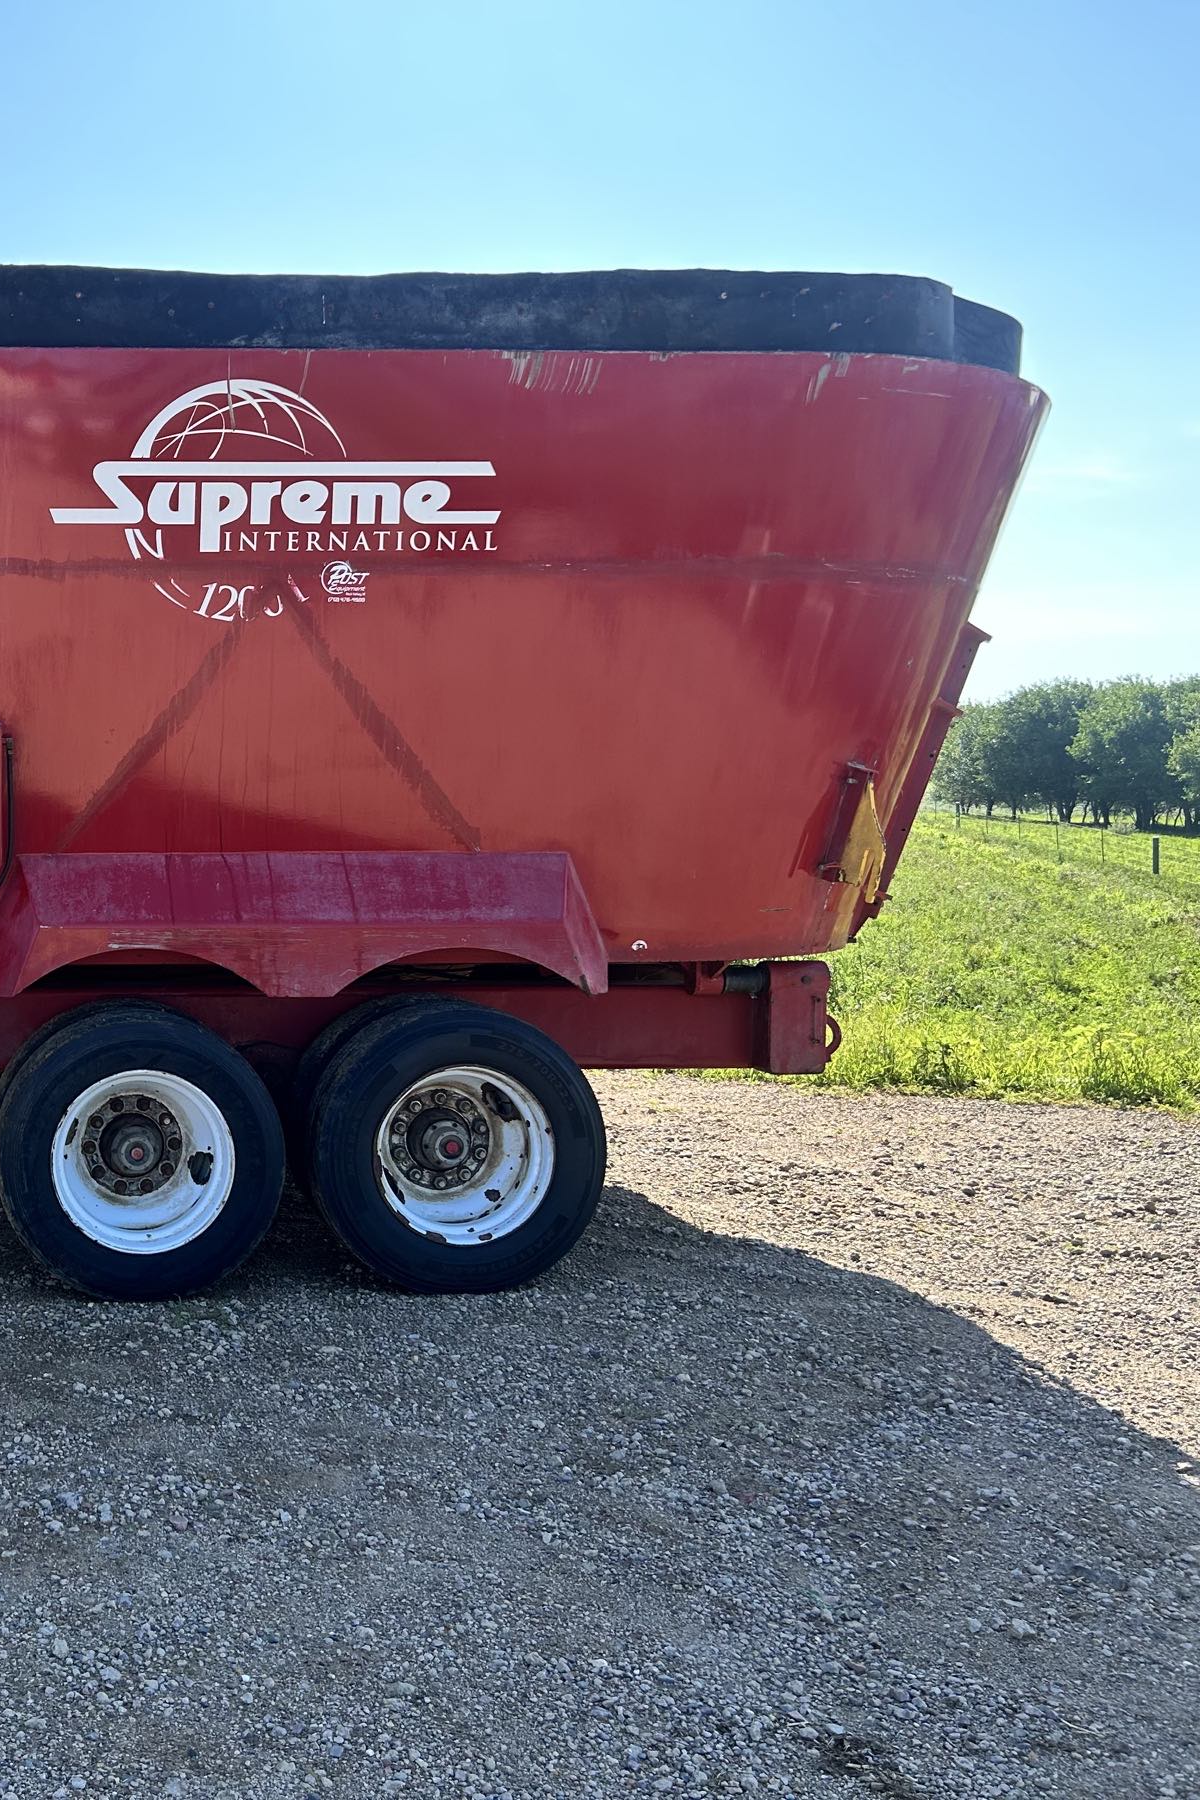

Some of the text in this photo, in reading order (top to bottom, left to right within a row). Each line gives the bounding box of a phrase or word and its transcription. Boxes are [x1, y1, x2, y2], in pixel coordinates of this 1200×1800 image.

[49, 460, 502, 552] Supreme
[224, 530, 498, 552] INTERNATIONAL
[327, 565, 370, 585] POST
